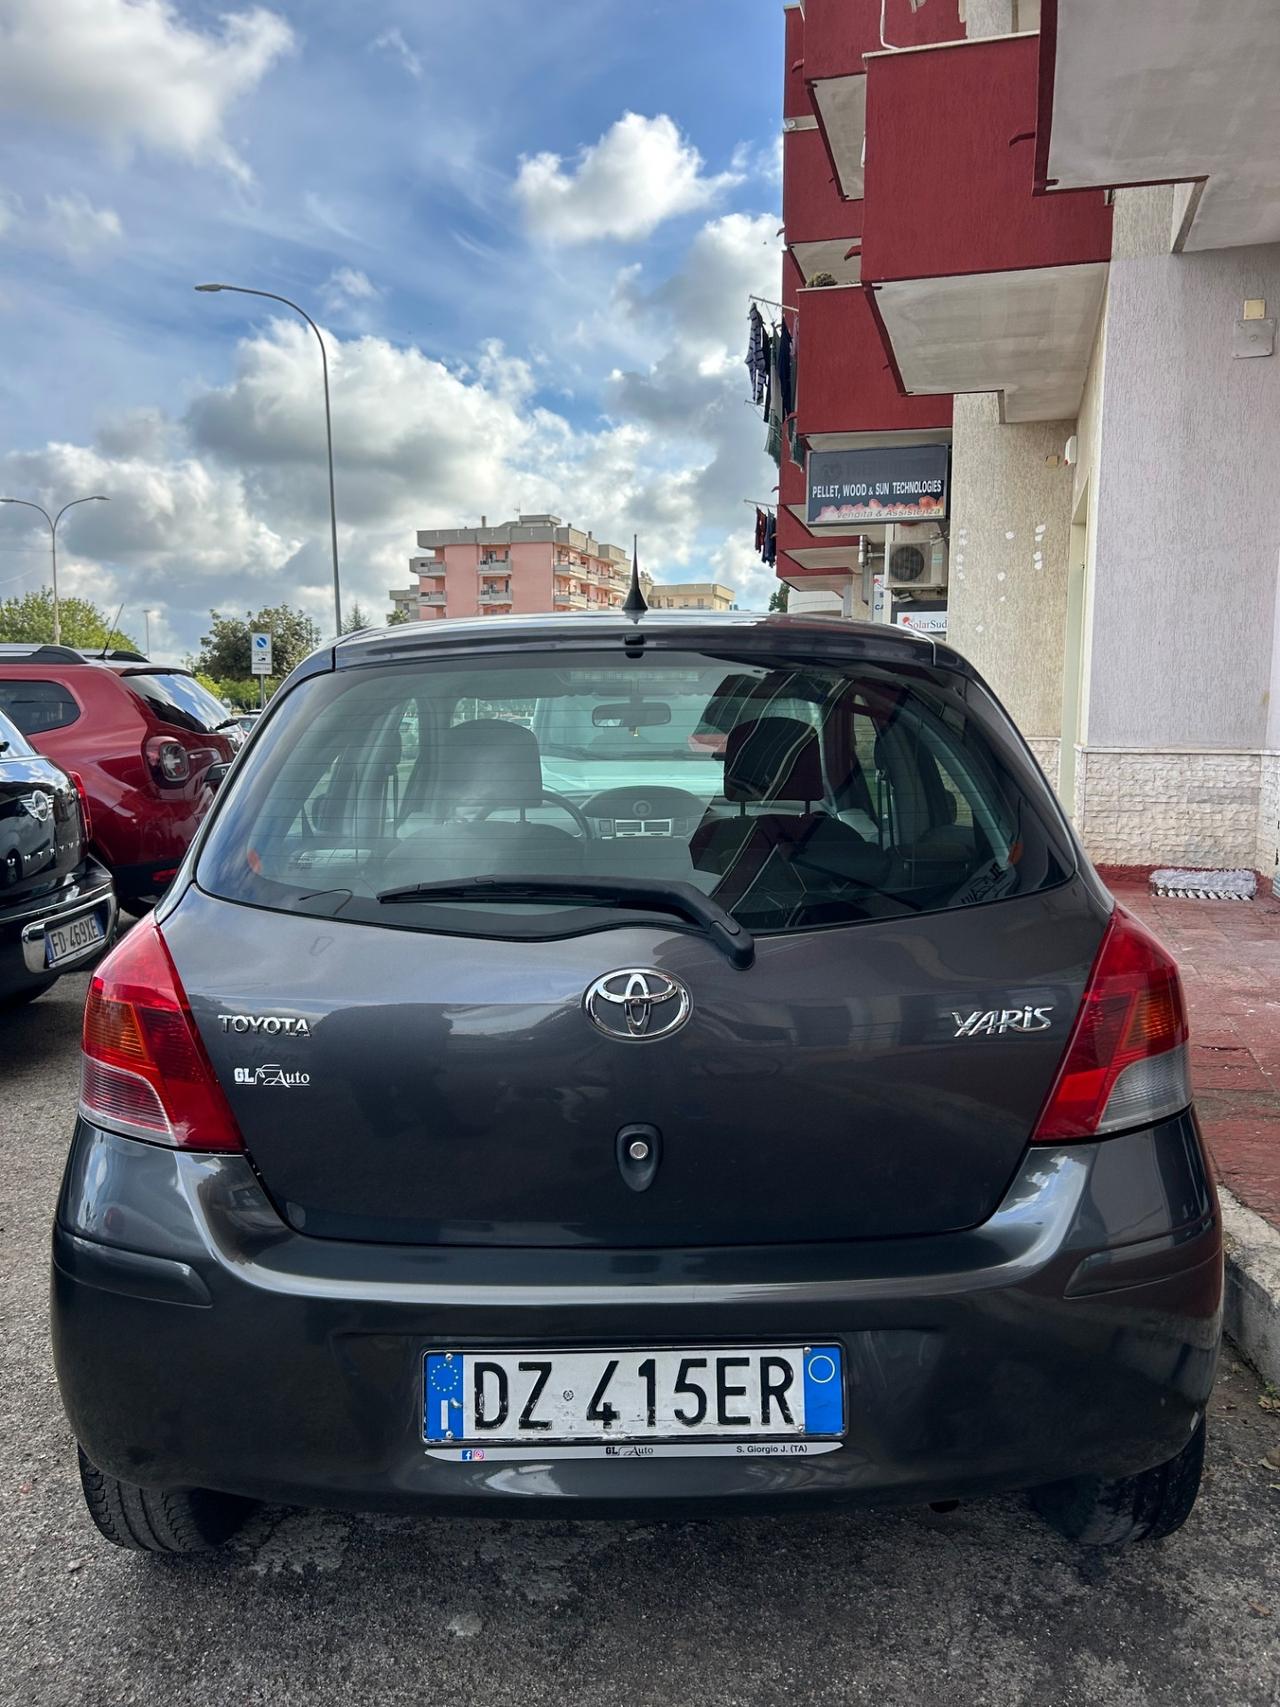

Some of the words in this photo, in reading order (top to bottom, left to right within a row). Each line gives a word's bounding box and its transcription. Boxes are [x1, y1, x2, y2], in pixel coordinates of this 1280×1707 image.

[812, 485, 841, 499] PELLET,
[843, 483, 867, 497] WOOD
[868, 486, 875, 495] &
[876, 482, 889, 495] SUN
[892, 479, 941, 494] TECHNOLOGIES
[875, 509, 882, 518] &
[50, 930, 67, 957] FD
[70, 916, 99, 947] 469XE
[217, 1014, 312, 1037] TOYOTA
[234, 1067, 255, 1083] GL
[263, 1070, 310, 1088] Auto
[474, 1361, 553, 1431] DZ
[586, 1356, 794, 1430] 415ER
[606, 1446, 618, 1455] GL
[624, 1446, 654, 1456] Auto
[736, 1445, 745, 1453] S.
[747, 1445, 778, 1454] Giorgio
[780, 1445, 788, 1453] J.
[790, 1444, 808, 1454] (TA)
